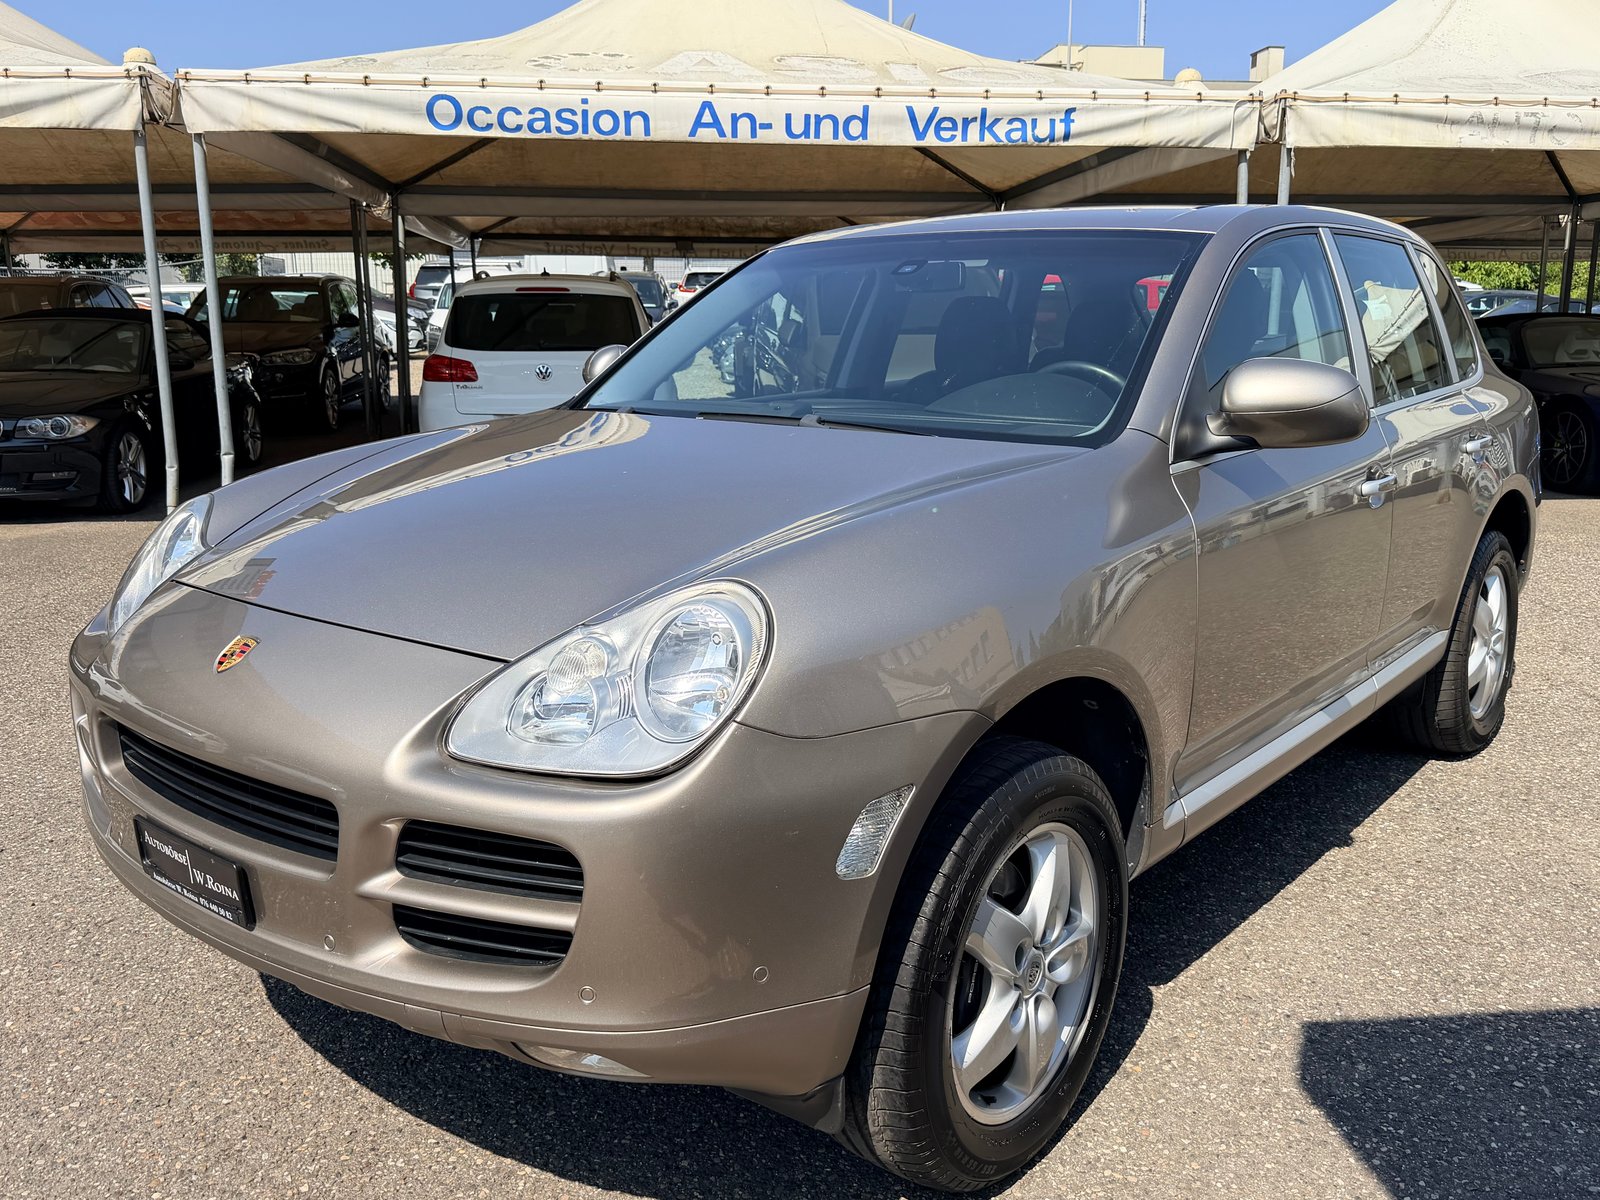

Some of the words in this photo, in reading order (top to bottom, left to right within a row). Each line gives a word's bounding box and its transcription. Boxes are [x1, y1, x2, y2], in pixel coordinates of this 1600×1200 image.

[425, 93, 651, 138] Occasion
[784, 104, 870, 142] und
[905, 105, 1077, 145] Verkauf
